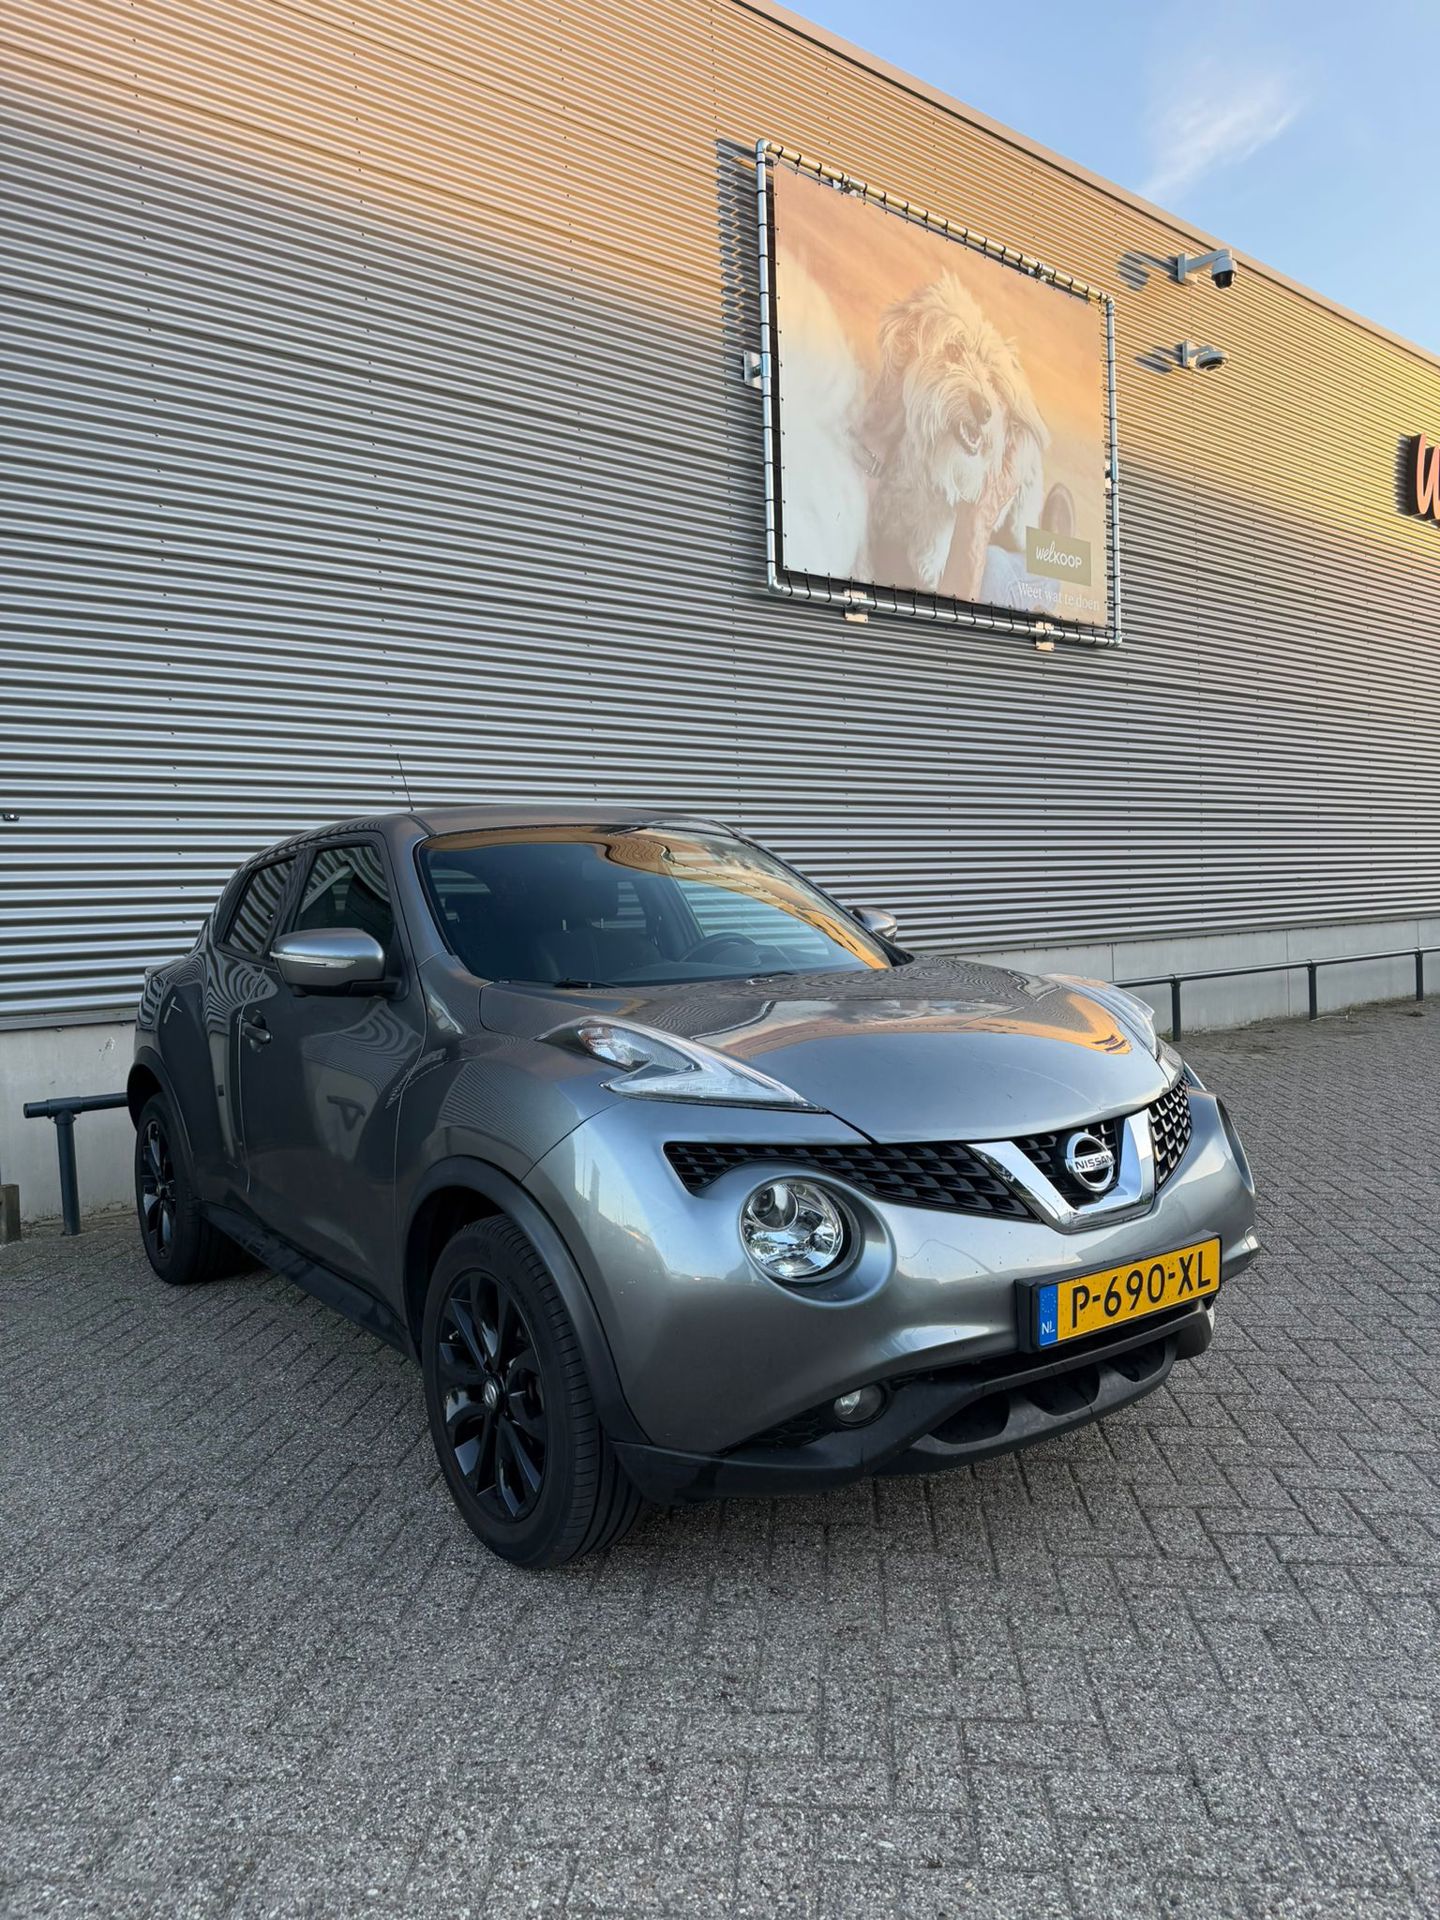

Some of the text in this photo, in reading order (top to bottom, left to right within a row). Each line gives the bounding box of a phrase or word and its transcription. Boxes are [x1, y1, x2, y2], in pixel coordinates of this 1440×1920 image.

[1018, 582, 1042, 600] Weet
[1075, 593, 1100, 612] doen
[1075, 1154, 1113, 1170] NISSAN
[1072, 1251, 1211, 1328] P-690-XL
[1041, 1320, 1056, 1335] NL
